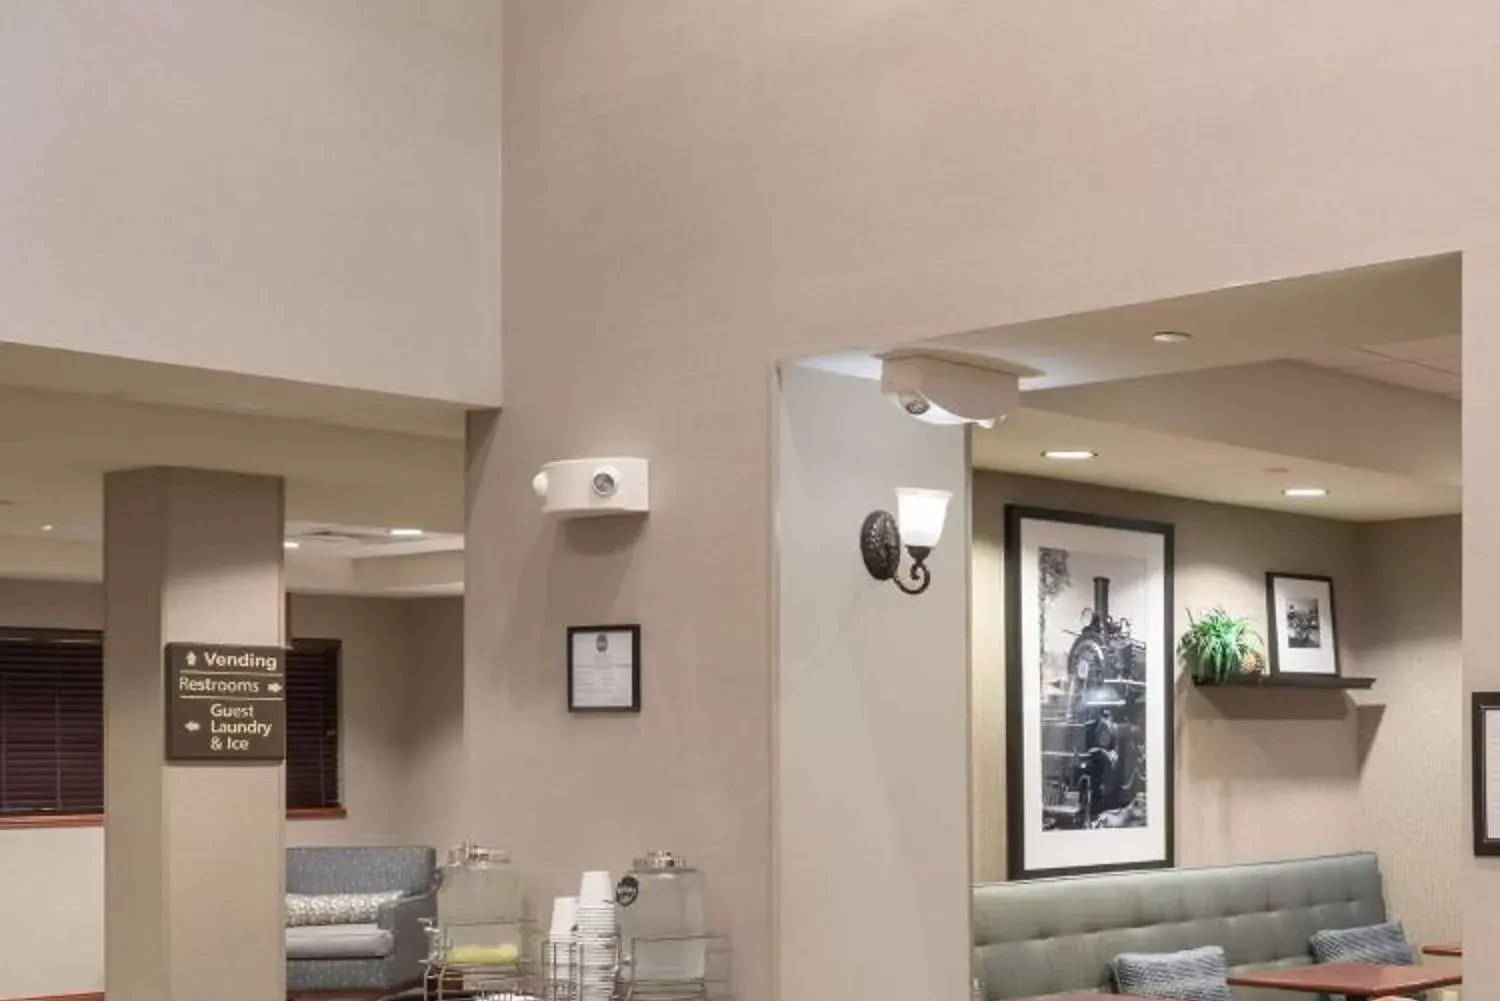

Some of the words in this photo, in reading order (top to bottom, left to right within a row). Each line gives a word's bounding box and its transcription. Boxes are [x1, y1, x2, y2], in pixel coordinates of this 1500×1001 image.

[204, 652, 277, 671] Vending
[179, 676, 260, 692] Restrooms
[210, 703, 255, 718] Guest
[211, 719, 273, 737] Laundry
[210, 735, 222, 751] &
[227, 737, 249, 751] Ice
